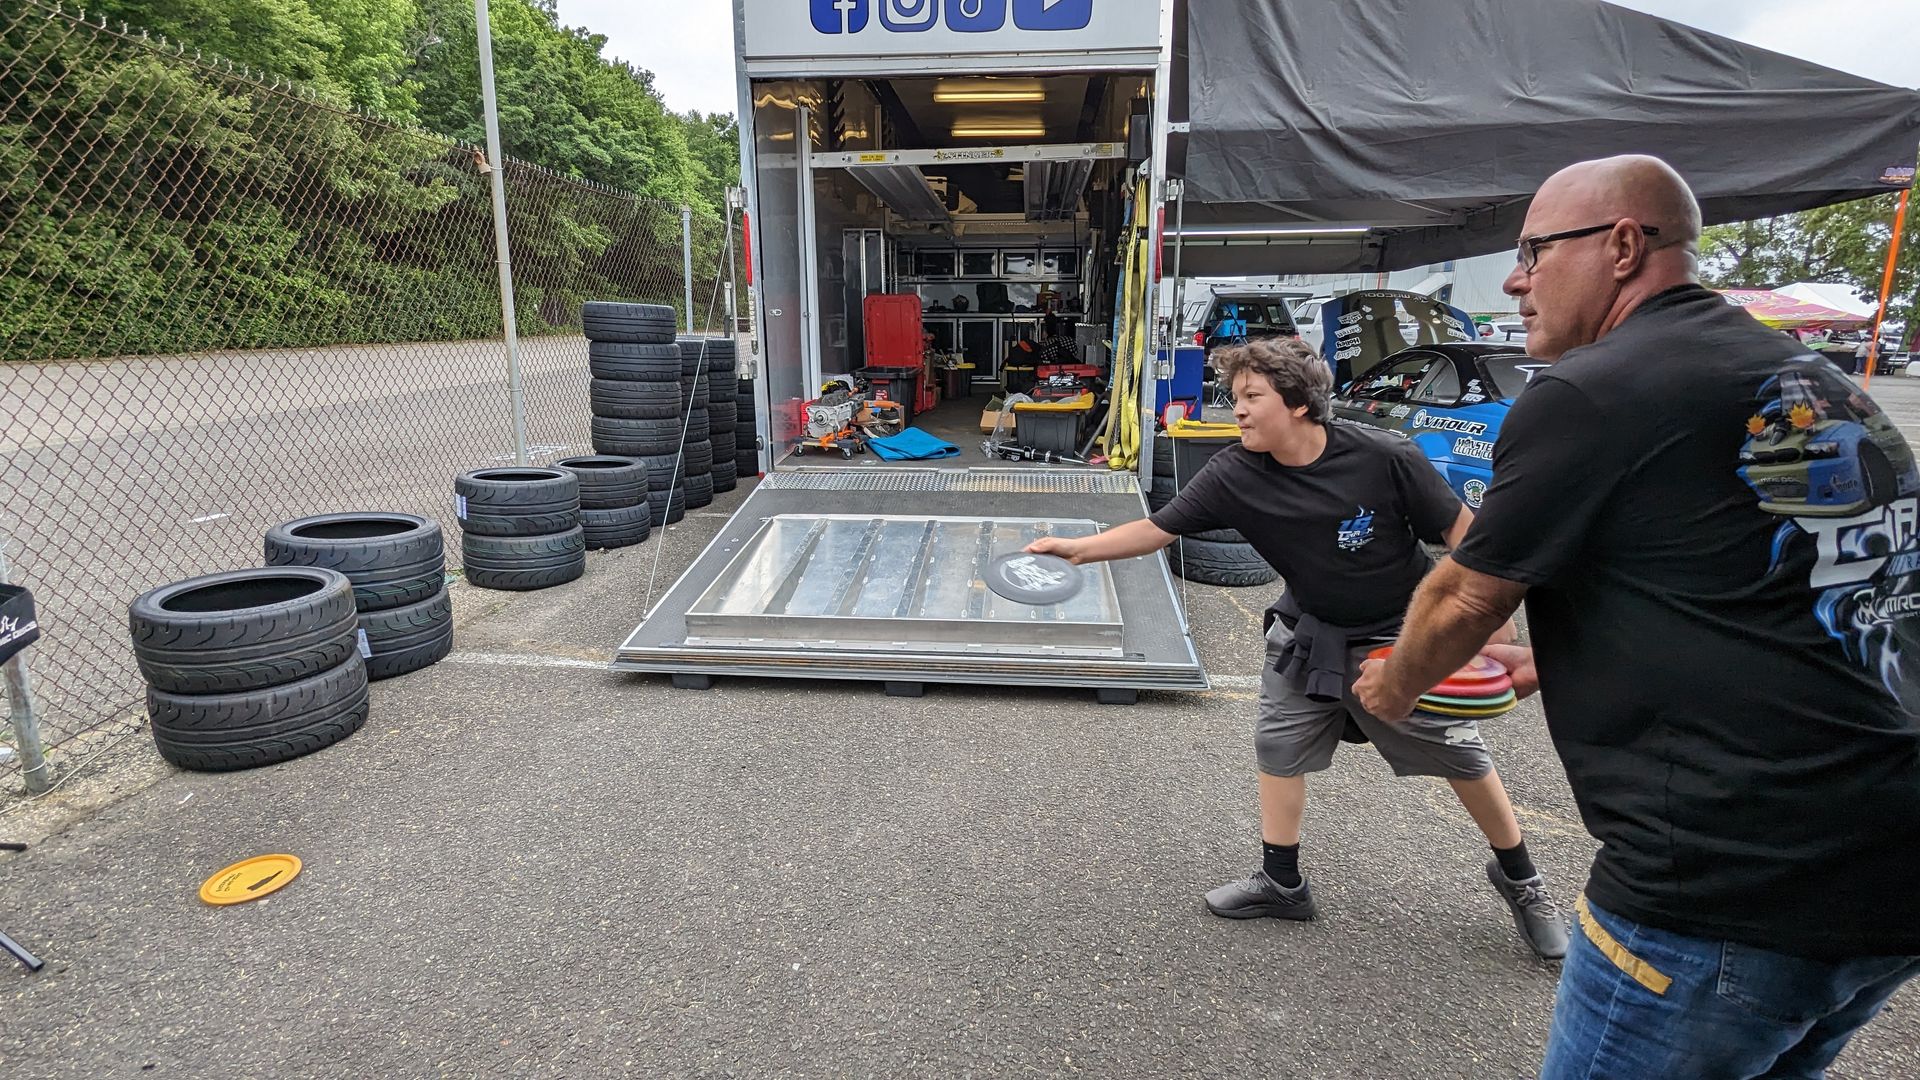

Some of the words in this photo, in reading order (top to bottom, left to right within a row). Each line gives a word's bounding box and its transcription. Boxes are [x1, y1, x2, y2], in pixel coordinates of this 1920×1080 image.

[1336, 338, 1360, 348] Holley
[1424, 416, 1486, 434] VITOUR
[1458, 438, 1493, 451] MONSTE
[1454, 446, 1481, 457] CLUTCH
